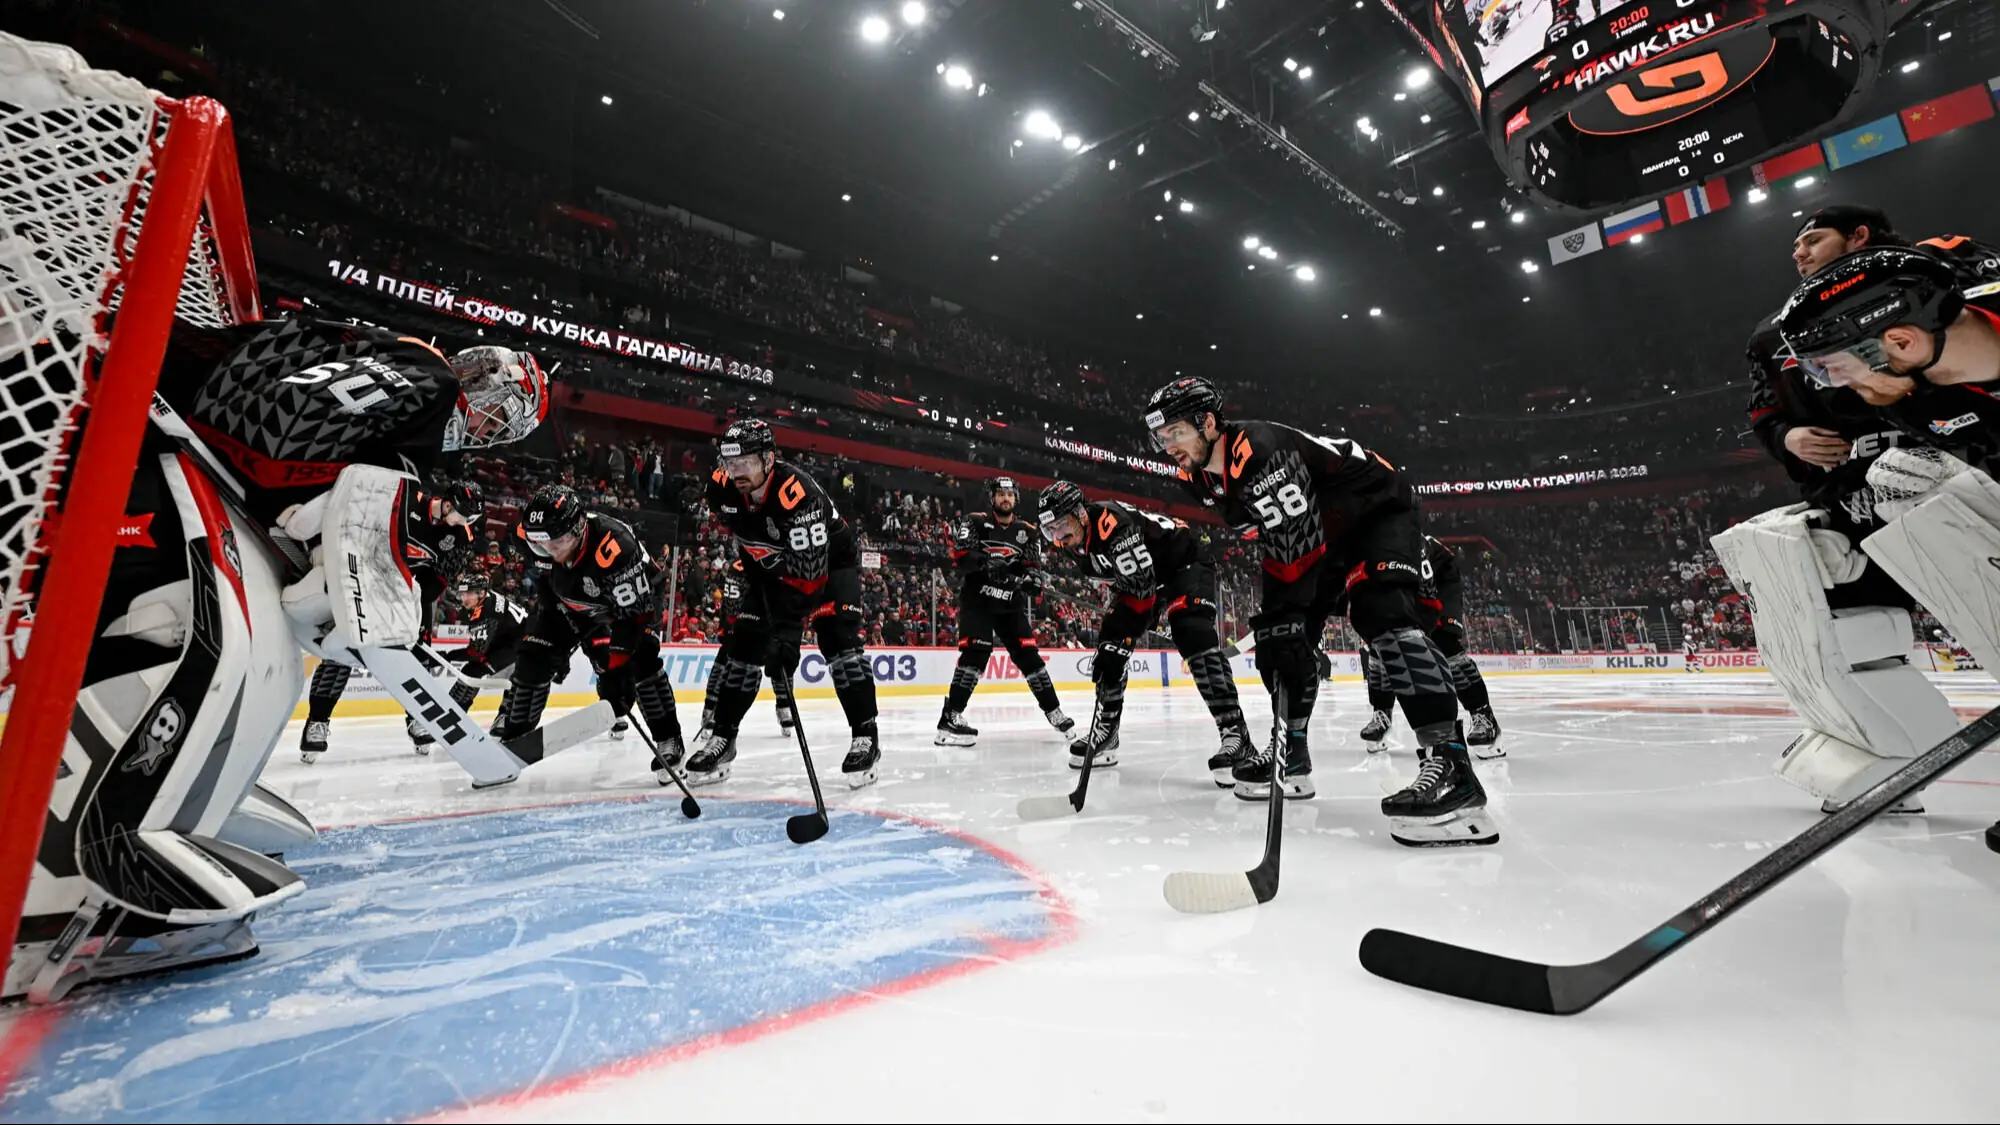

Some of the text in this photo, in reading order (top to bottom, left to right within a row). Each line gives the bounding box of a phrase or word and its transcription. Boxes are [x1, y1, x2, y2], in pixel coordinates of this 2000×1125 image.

[1609, 5, 1650, 35] 20:00
[1622, 20, 1648, 36] период
[1571, 39, 1590, 60] 0
[1574, 12, 1717, 92] HAWK.RU
[1677, 130, 1710, 151] 20:00
[1722, 132, 1744, 145] ЦСКА
[1641, 155, 1681, 176] АВАНГАРД
[1713, 151, 1725, 164] 0
[1678, 165, 1689, 177] 0
[328, 259, 774, 385] 1/4 ПЛЕЙ-ОФФ КУБКА ГАГАРИНА 2026
[1858, 300, 1901, 325] CCM
[931, 409, 940, 421] 0
[964, 418, 972, 429] 0
[1045, 436, 1090, 456] КАЖДЫЙ
[1092, 447, 1117, 463] ДЕНЬ
[1126, 455, 1146, 470] КАК
[1253, 467, 1288, 497] ONBET
[1418, 483, 1484, 494] ПЛЕЙ-ОФФ
[1487, 478, 1531, 491] КУБКА
[1533, 470, 1607, 488] ГАГАРИНА
[1253, 482, 1308, 530] 58
[529, 511, 544, 524] 84
[795, 509, 822, 526] ONBET
[789, 522, 828, 551] 88
[1097, 554, 1113, 569] A
[1115, 543, 1153, 576] 65
[612, 572, 650, 607] 84
[723, 583, 741, 599] 55
[1256, 622, 1305, 641] CCM
[1606, 656, 1669, 669] KHL.RU
